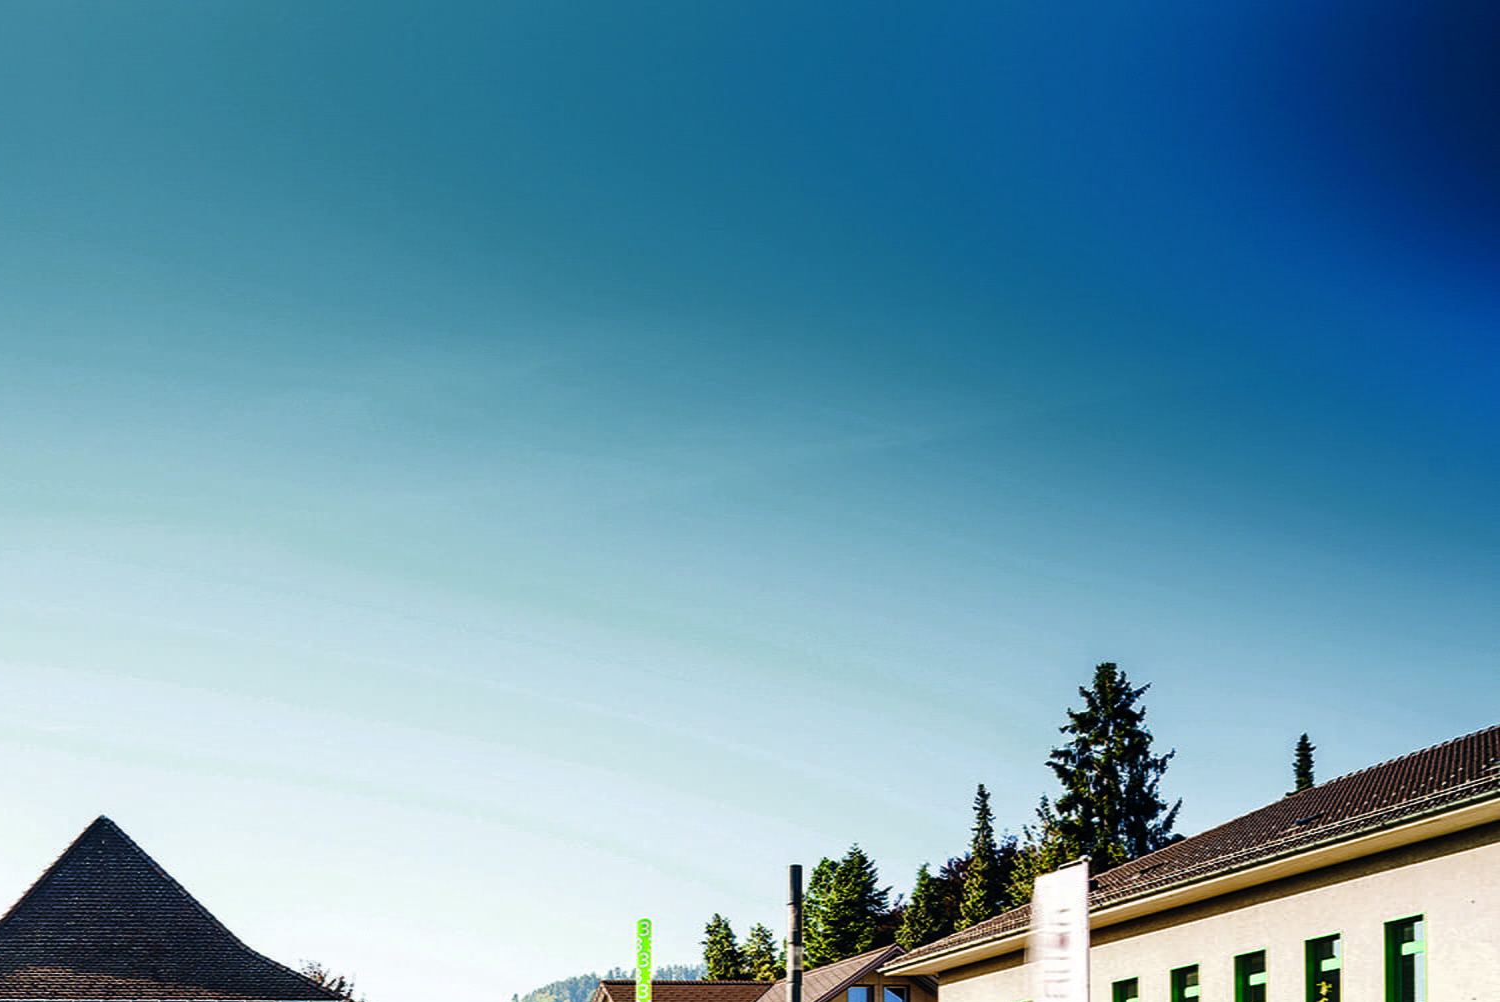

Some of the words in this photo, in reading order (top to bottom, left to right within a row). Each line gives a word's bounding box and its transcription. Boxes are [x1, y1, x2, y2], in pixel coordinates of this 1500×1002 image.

[640, 921, 650, 936] 3
[639, 952, 649, 967] 3
[639, 983, 649, 999] 3
